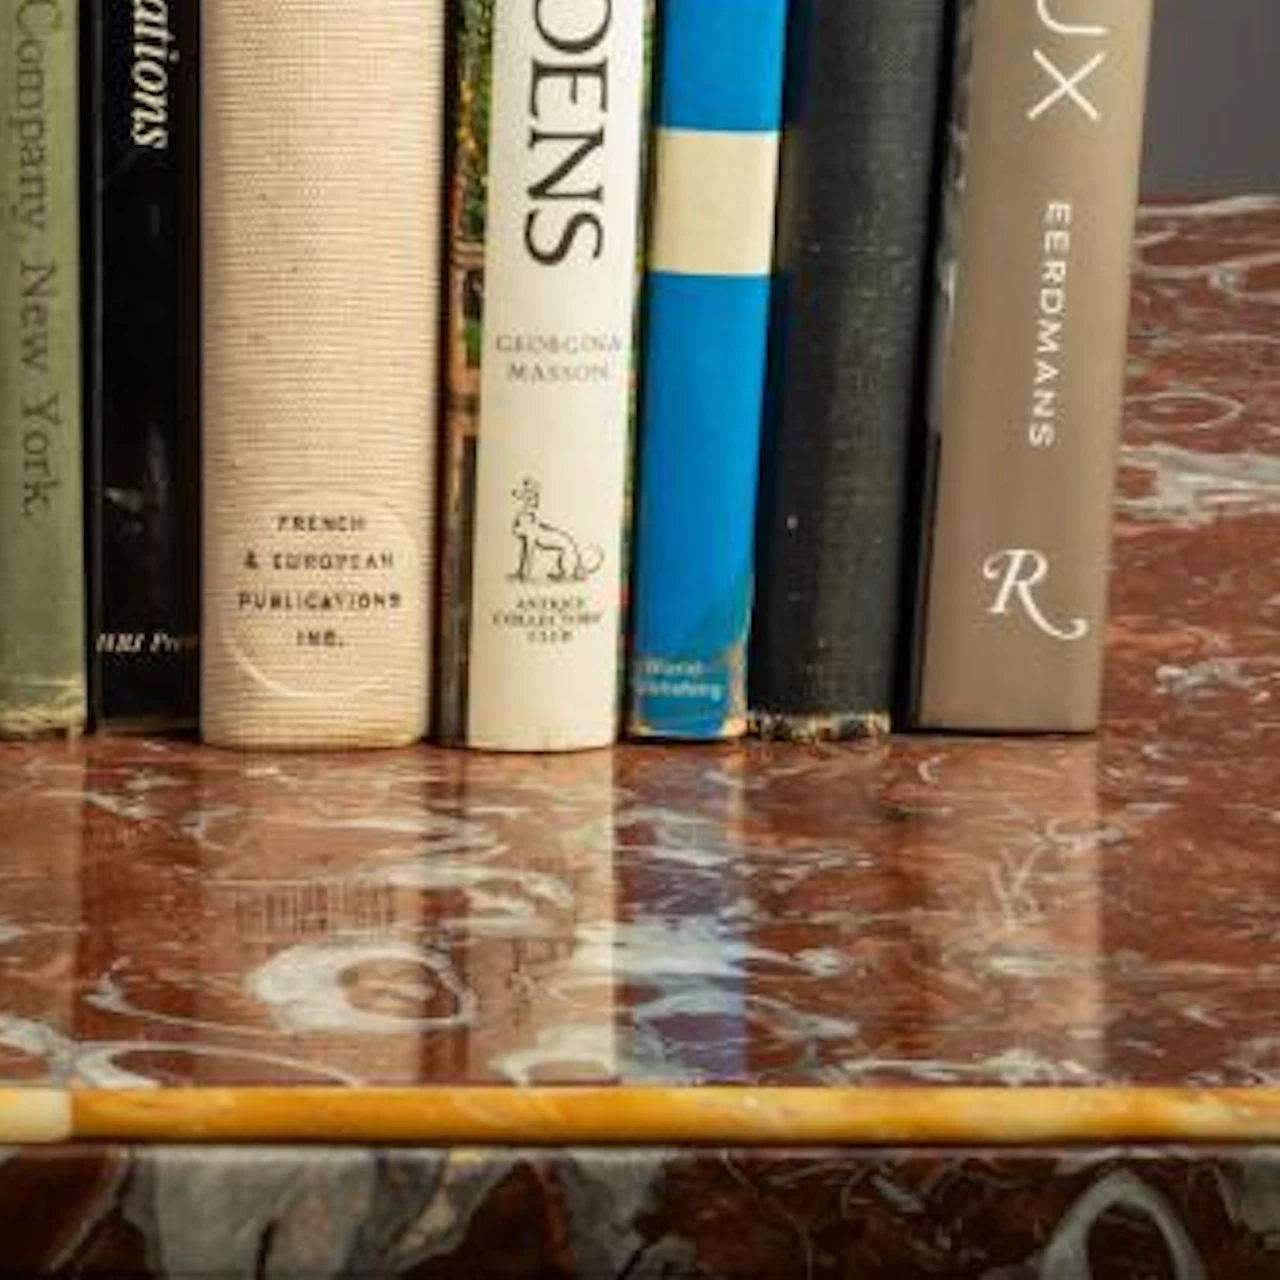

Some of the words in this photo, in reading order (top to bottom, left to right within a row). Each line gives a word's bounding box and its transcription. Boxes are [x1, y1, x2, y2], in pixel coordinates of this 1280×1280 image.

[20, 260, 59, 372] New
[1028, 201, 1072, 449] EERDMANS
[496, 334, 623, 354] GEORGINA
[507, 362, 611, 383] MASSON
[276, 515, 367, 532] FRENCH
[272, 551, 394, 571] EUROPEAN
[238, 591, 403, 611] PUBLICATIONS
[982, 548, 1088, 641] R
